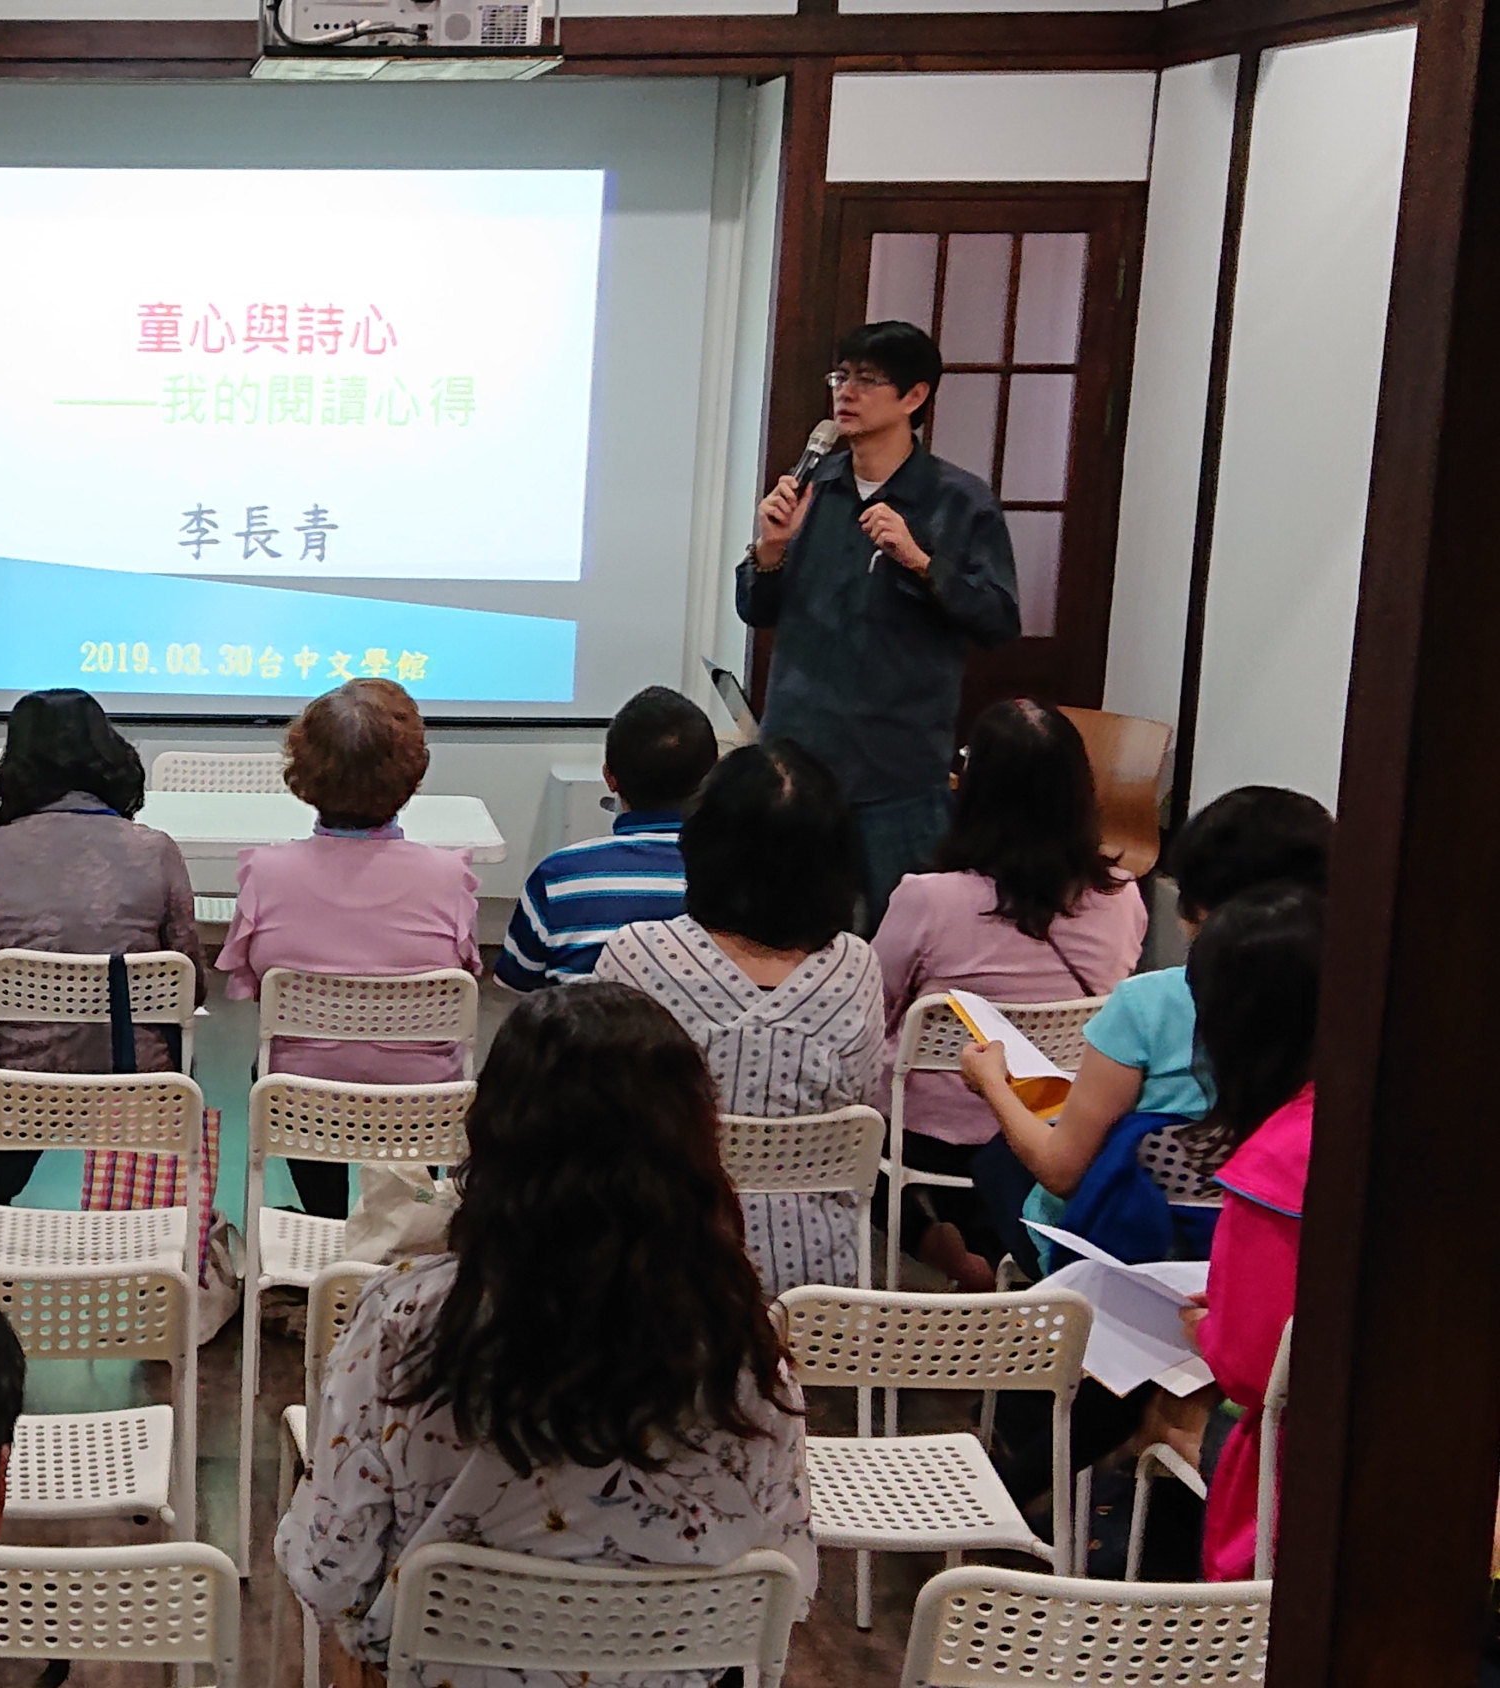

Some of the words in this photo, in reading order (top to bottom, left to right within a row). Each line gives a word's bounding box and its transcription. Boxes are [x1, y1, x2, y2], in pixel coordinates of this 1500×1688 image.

[137, 302, 397, 355] 童心與詩心
[178, 502, 340, 562] 李長青
